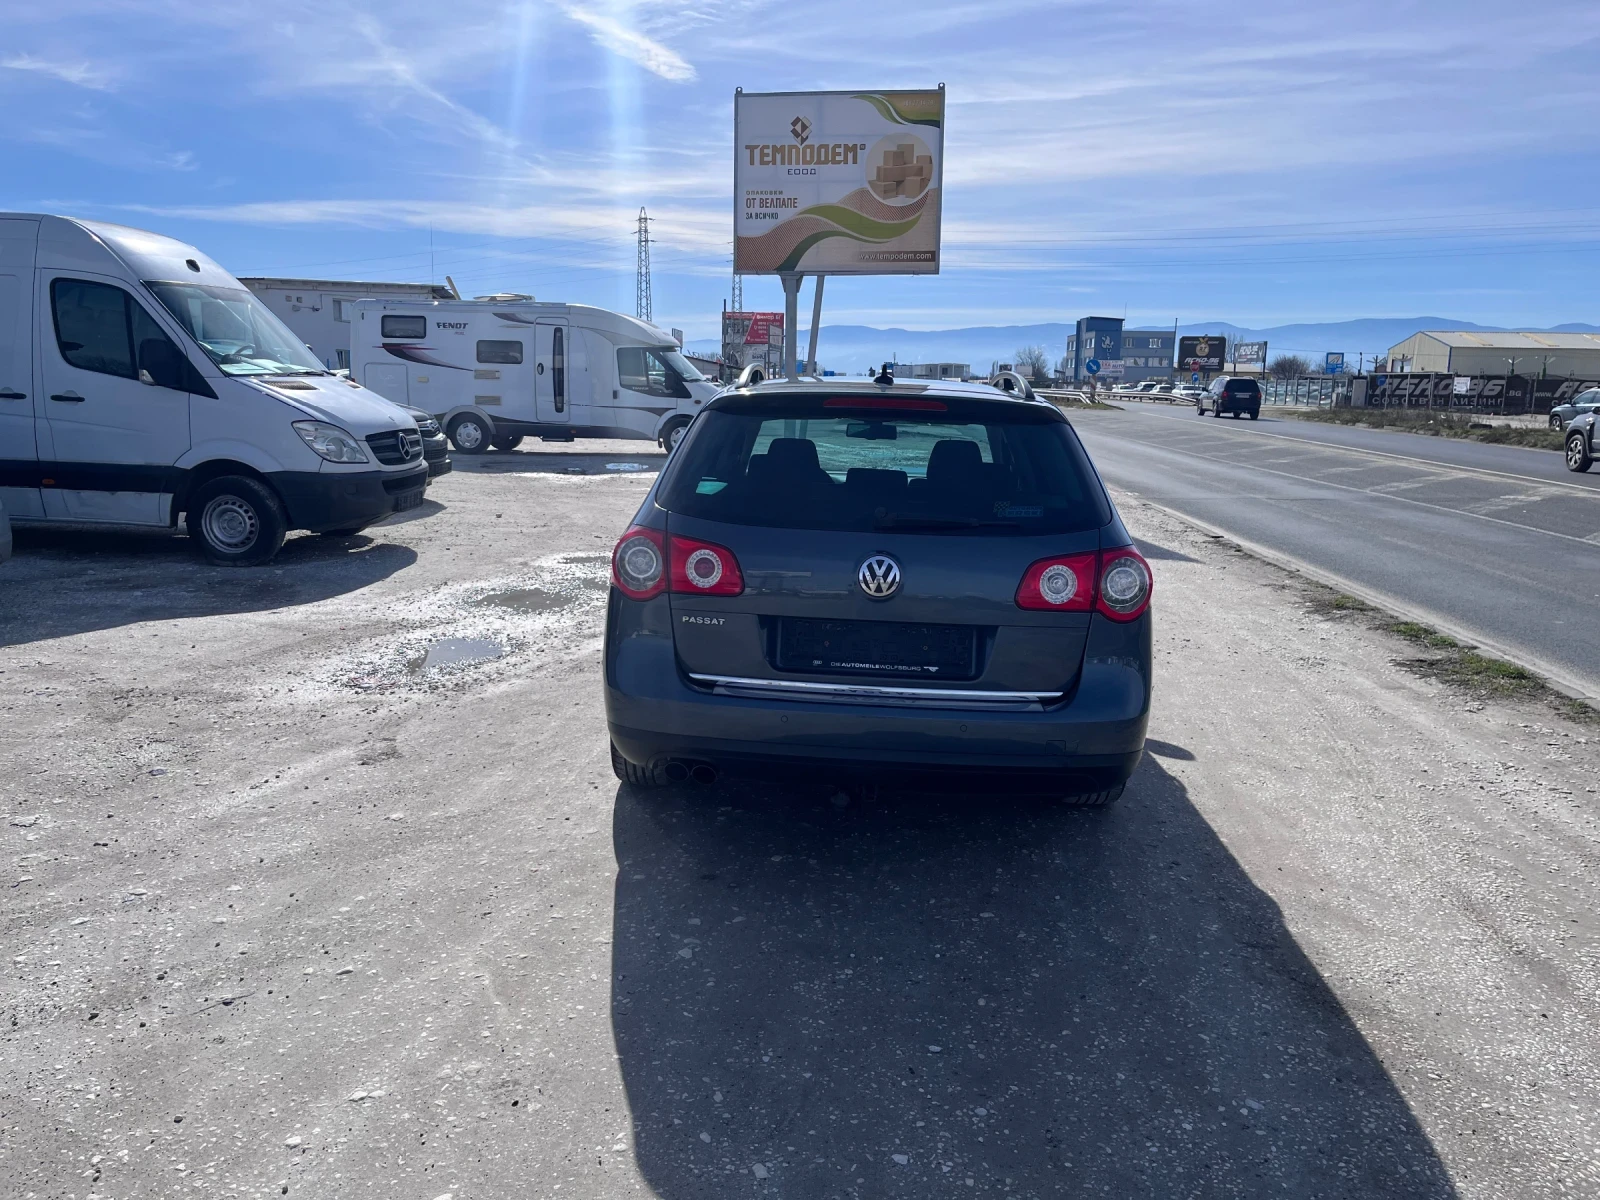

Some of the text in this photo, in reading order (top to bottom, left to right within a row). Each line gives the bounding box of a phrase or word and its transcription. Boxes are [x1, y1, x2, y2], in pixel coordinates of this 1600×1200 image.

[745, 144, 858, 166] ТЕМПОДЕМ
[787, 168, 817, 176] ЕООД
[745, 197, 798, 209] ОТ ВЕЛПАПЕ
[745, 212, 779, 220] ЗА ВСИЧКО
[859, 251, 932, 261] www.tempodem.com
[682, 615, 726, 626] PASSAT
